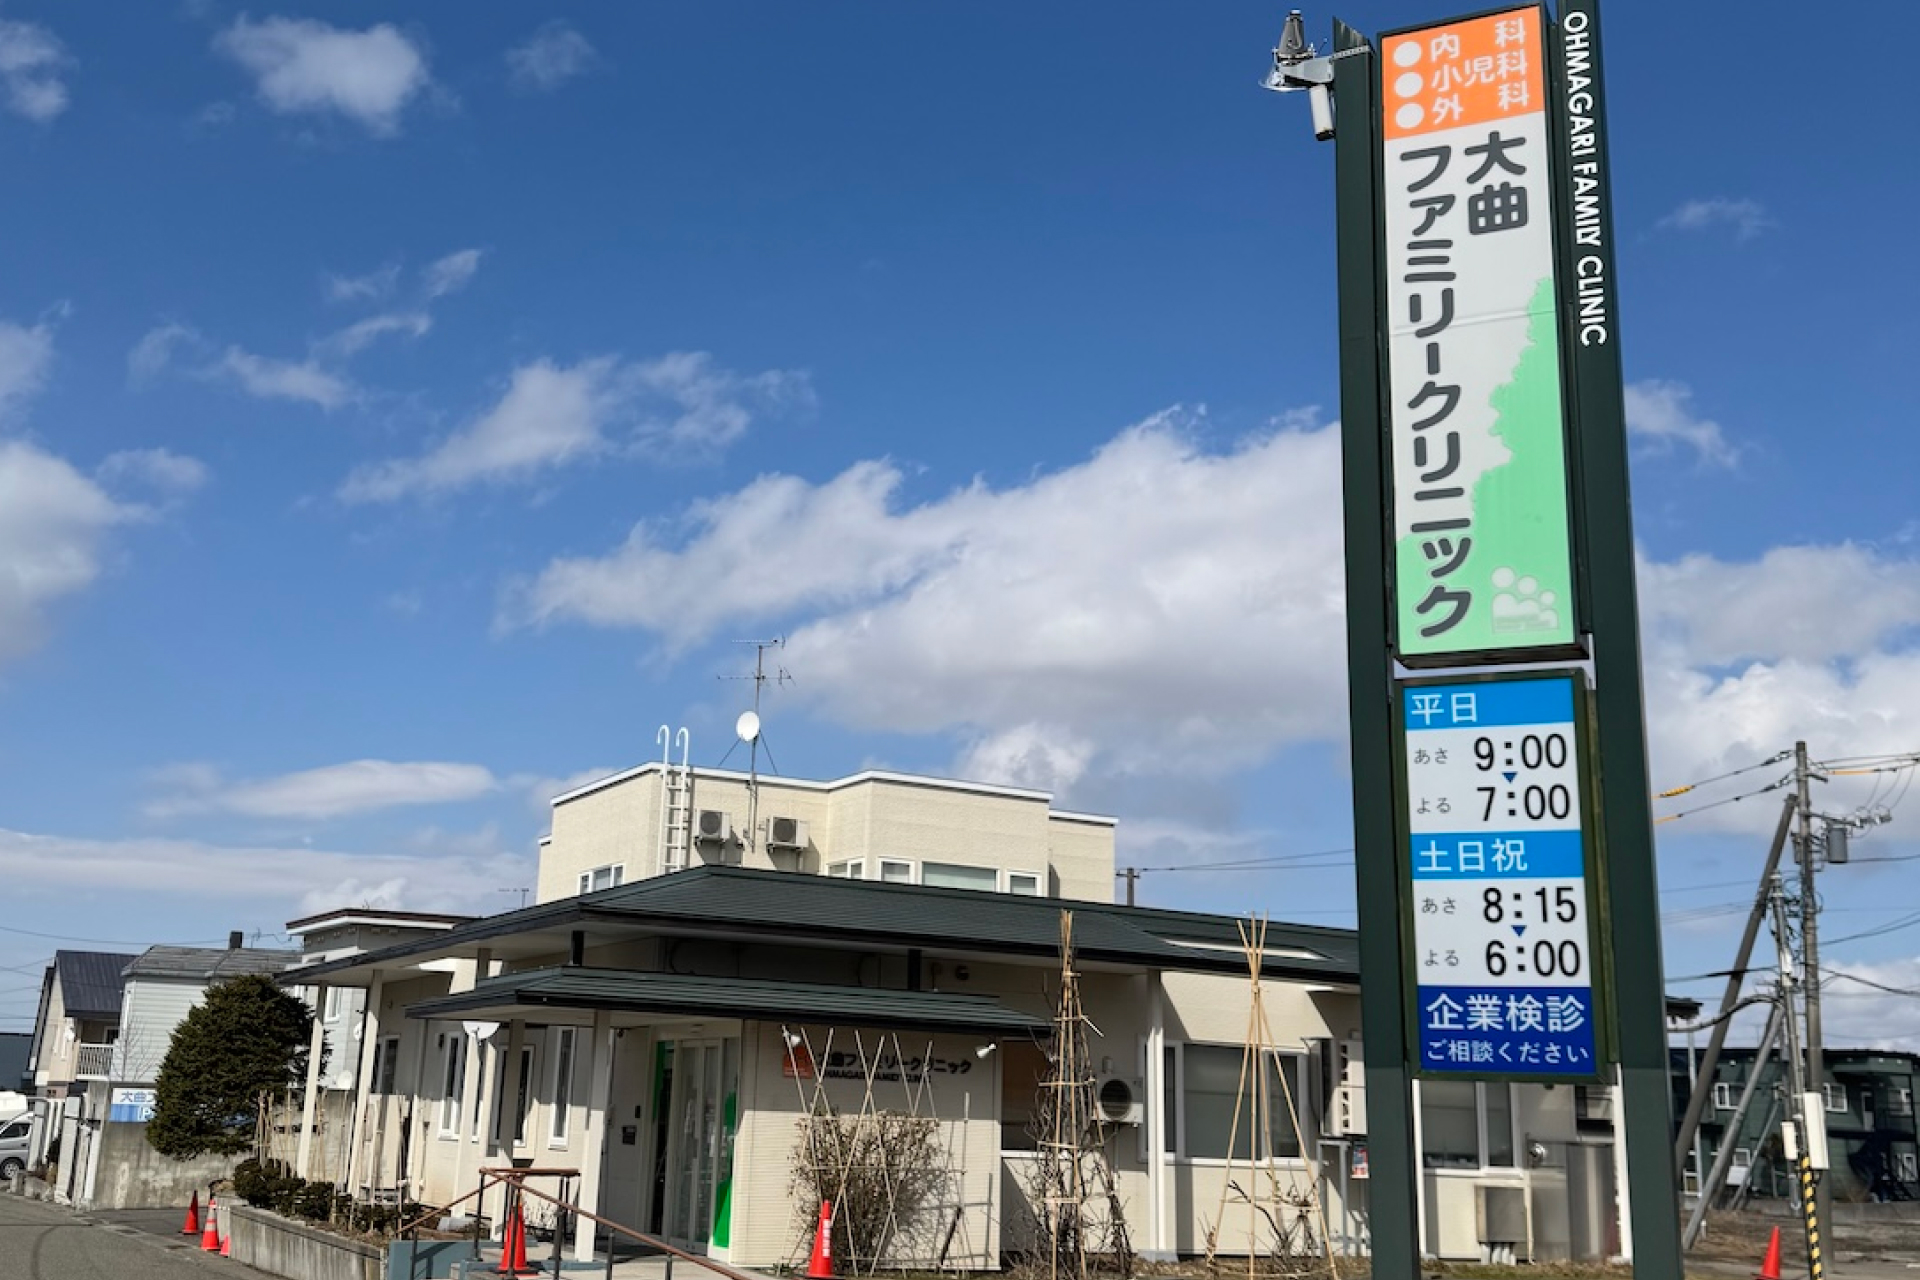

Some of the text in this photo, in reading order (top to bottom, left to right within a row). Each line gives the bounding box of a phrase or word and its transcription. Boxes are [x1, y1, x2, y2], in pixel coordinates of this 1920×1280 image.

[1431, 48, 1528, 92] 小児科
[1464, 131, 1528, 235] 大曲
[1564, 11, 1608, 346] OHMAGARI FAMILY CLINIC
[1399, 145, 1472, 638] ファミリークリニック
[1410, 692, 1477, 725] 平日
[1414, 733, 1567, 771] あさ 9:00
[1416, 784, 1571, 821] よる 7:00
[1417, 838, 1528, 872] 土日祝
[1421, 886, 1577, 923] あさ 8:15
[1424, 939, 1581, 976] よる 6:00
[1426, 992, 1585, 1032] 企業検診
[1427, 1038, 1590, 1064] ご相談ください
